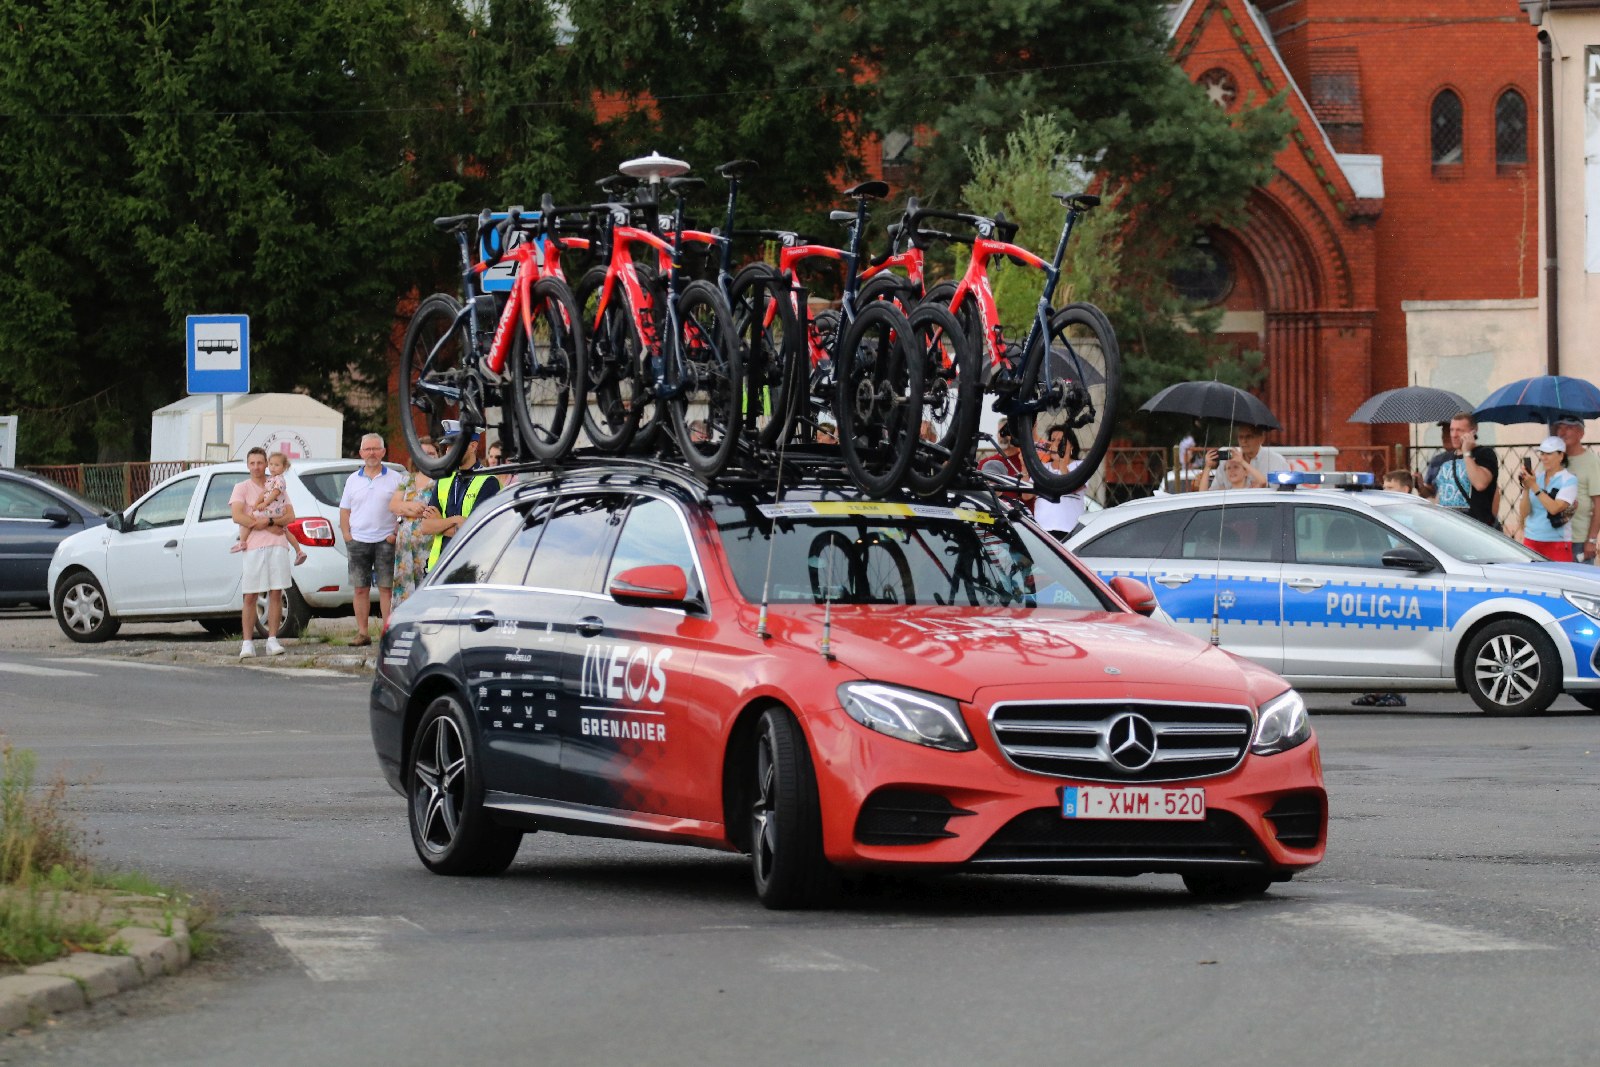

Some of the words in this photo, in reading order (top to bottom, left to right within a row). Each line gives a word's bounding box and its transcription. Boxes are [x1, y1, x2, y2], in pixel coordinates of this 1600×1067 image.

[1326, 592, 1422, 620] POLICJA
[504, 653, 532, 663] PINARELLO
[579, 643, 674, 704] INEOS
[580, 717, 667, 742] GRENADIER
[1066, 804, 1075, 814] B
[1081, 791, 1204, 815] 1-XWM-520
